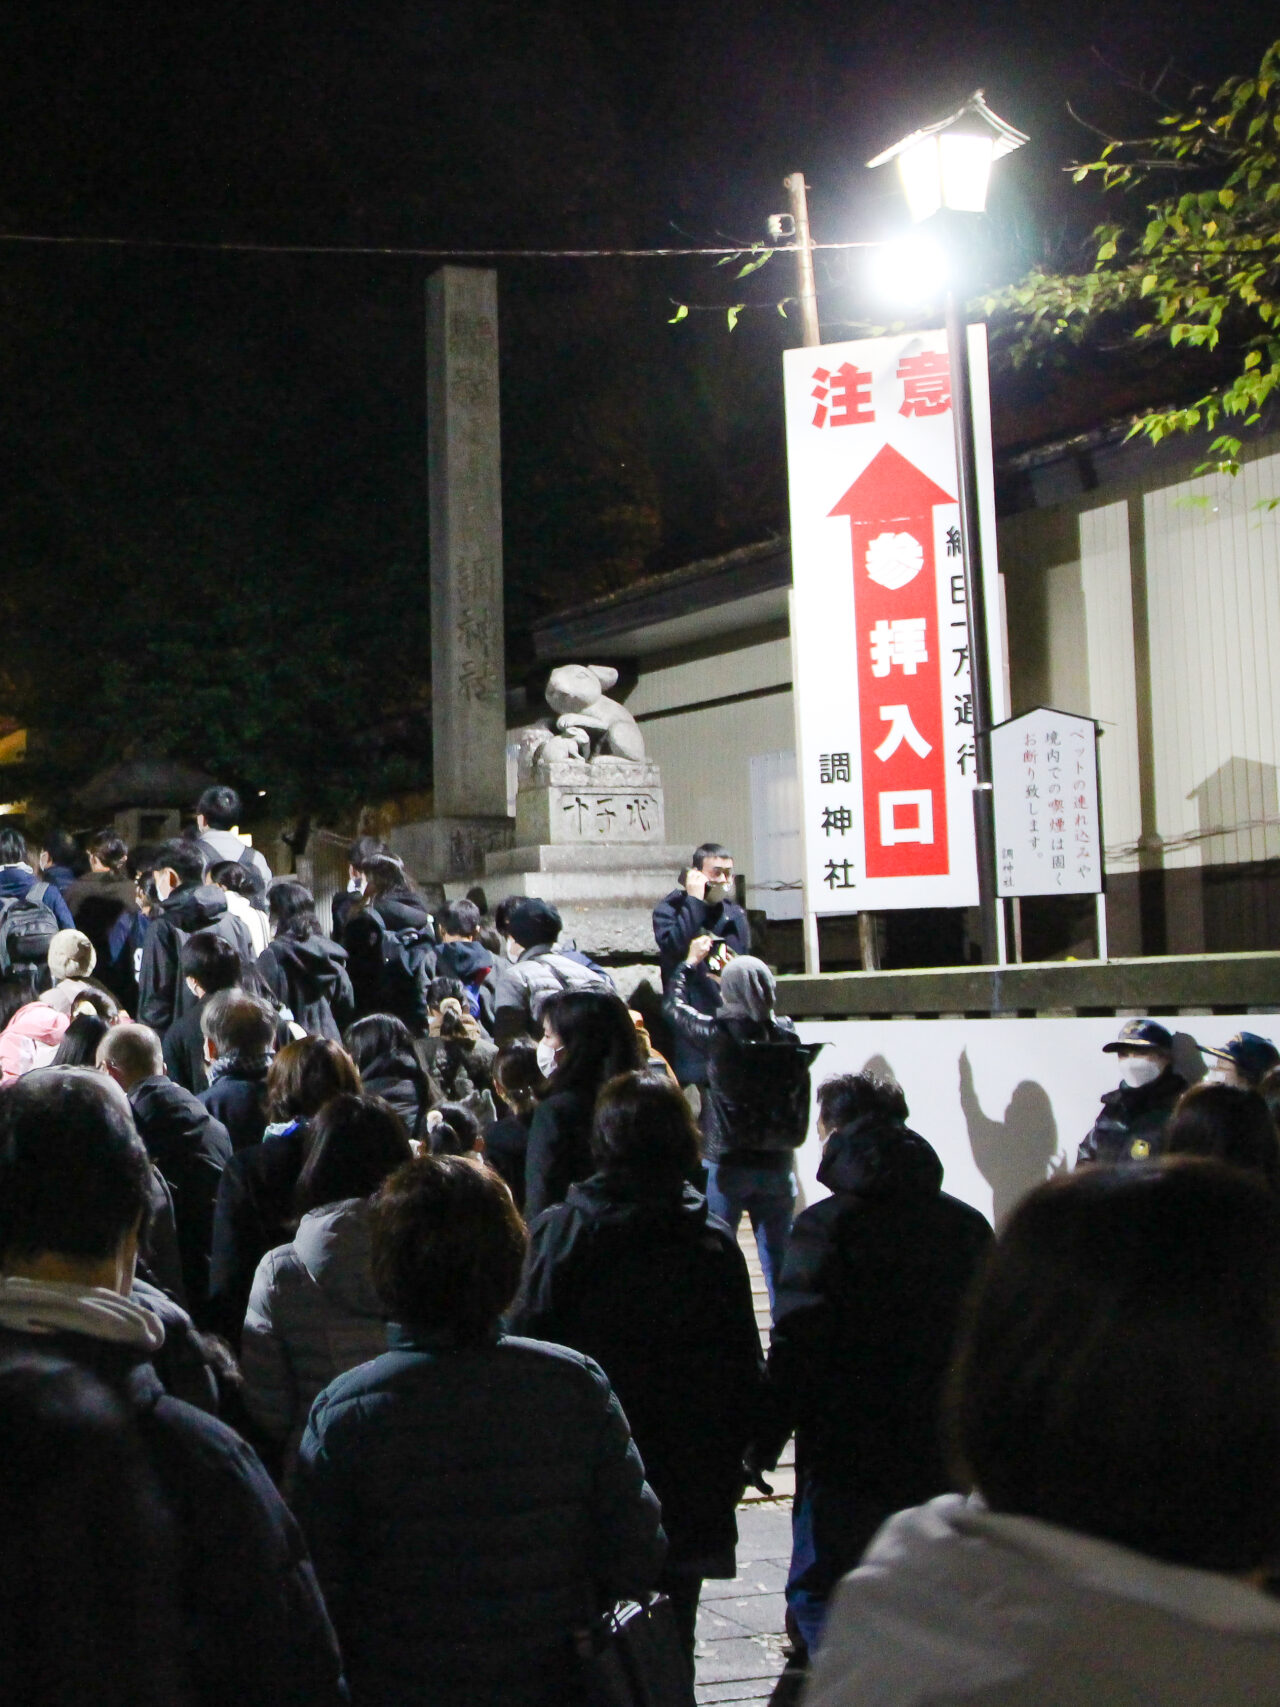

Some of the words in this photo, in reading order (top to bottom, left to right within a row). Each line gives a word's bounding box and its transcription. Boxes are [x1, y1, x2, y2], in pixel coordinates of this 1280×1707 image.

[811, 350, 953, 429] 注意
[864, 530, 933, 847] 参拝入口
[819, 752, 856, 890] 調神社
